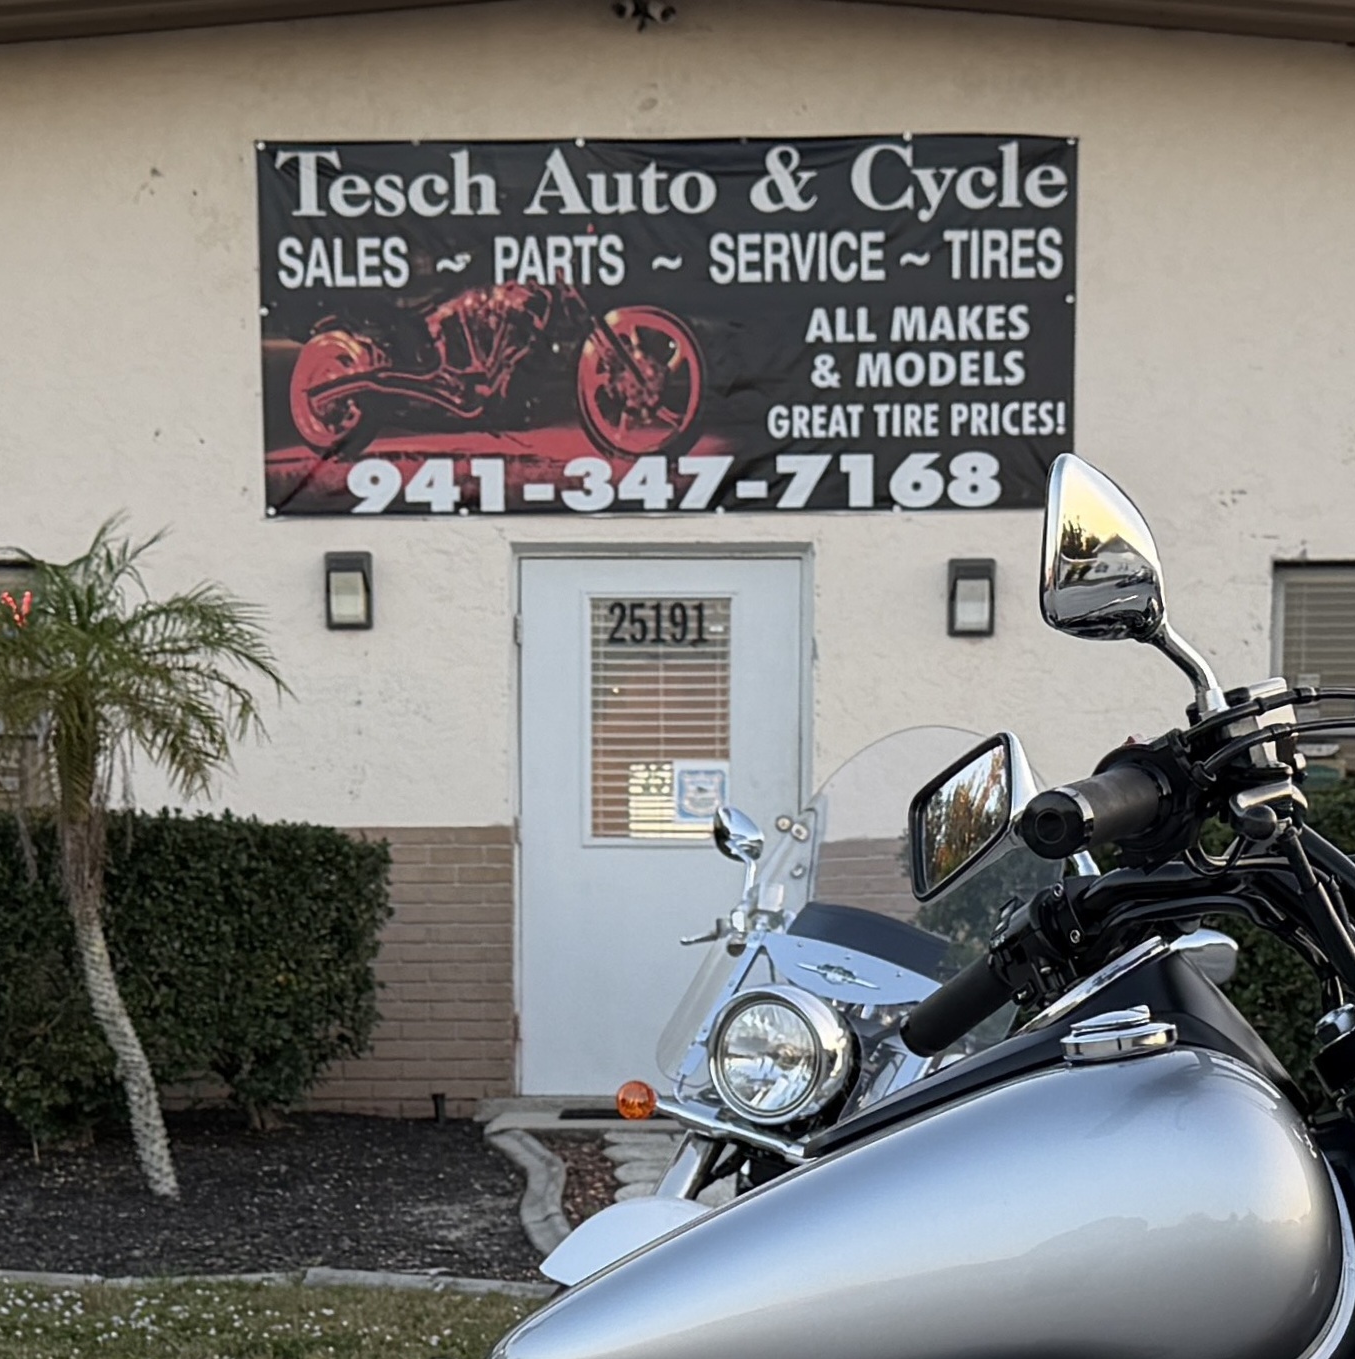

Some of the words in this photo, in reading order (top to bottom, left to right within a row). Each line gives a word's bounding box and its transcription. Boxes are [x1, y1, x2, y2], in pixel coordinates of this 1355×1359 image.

[275, 149, 501, 217] Tesch
[523, 147, 717, 215] Auto
[750, 145, 818, 213] &
[851, 141, 1069, 222] Cycle
[278, 236, 410, 289] SALES
[494, 234, 625, 286] PARTS
[709, 230, 886, 285] SERVICE
[943, 227, 1063, 280] TIRES
[805, 305, 877, 343] ALL
[890, 304, 1030, 342] MAKES
[810, 352, 841, 388] &
[855, 350, 1025, 388] MODELS
[767, 403, 865, 439] GREAT
[873, 402, 939, 438] TIRE
[950, 401, 1066, 437] PRICES!
[346, 452, 1002, 513] 941-347-7168
[608, 602, 708, 645] 25191
